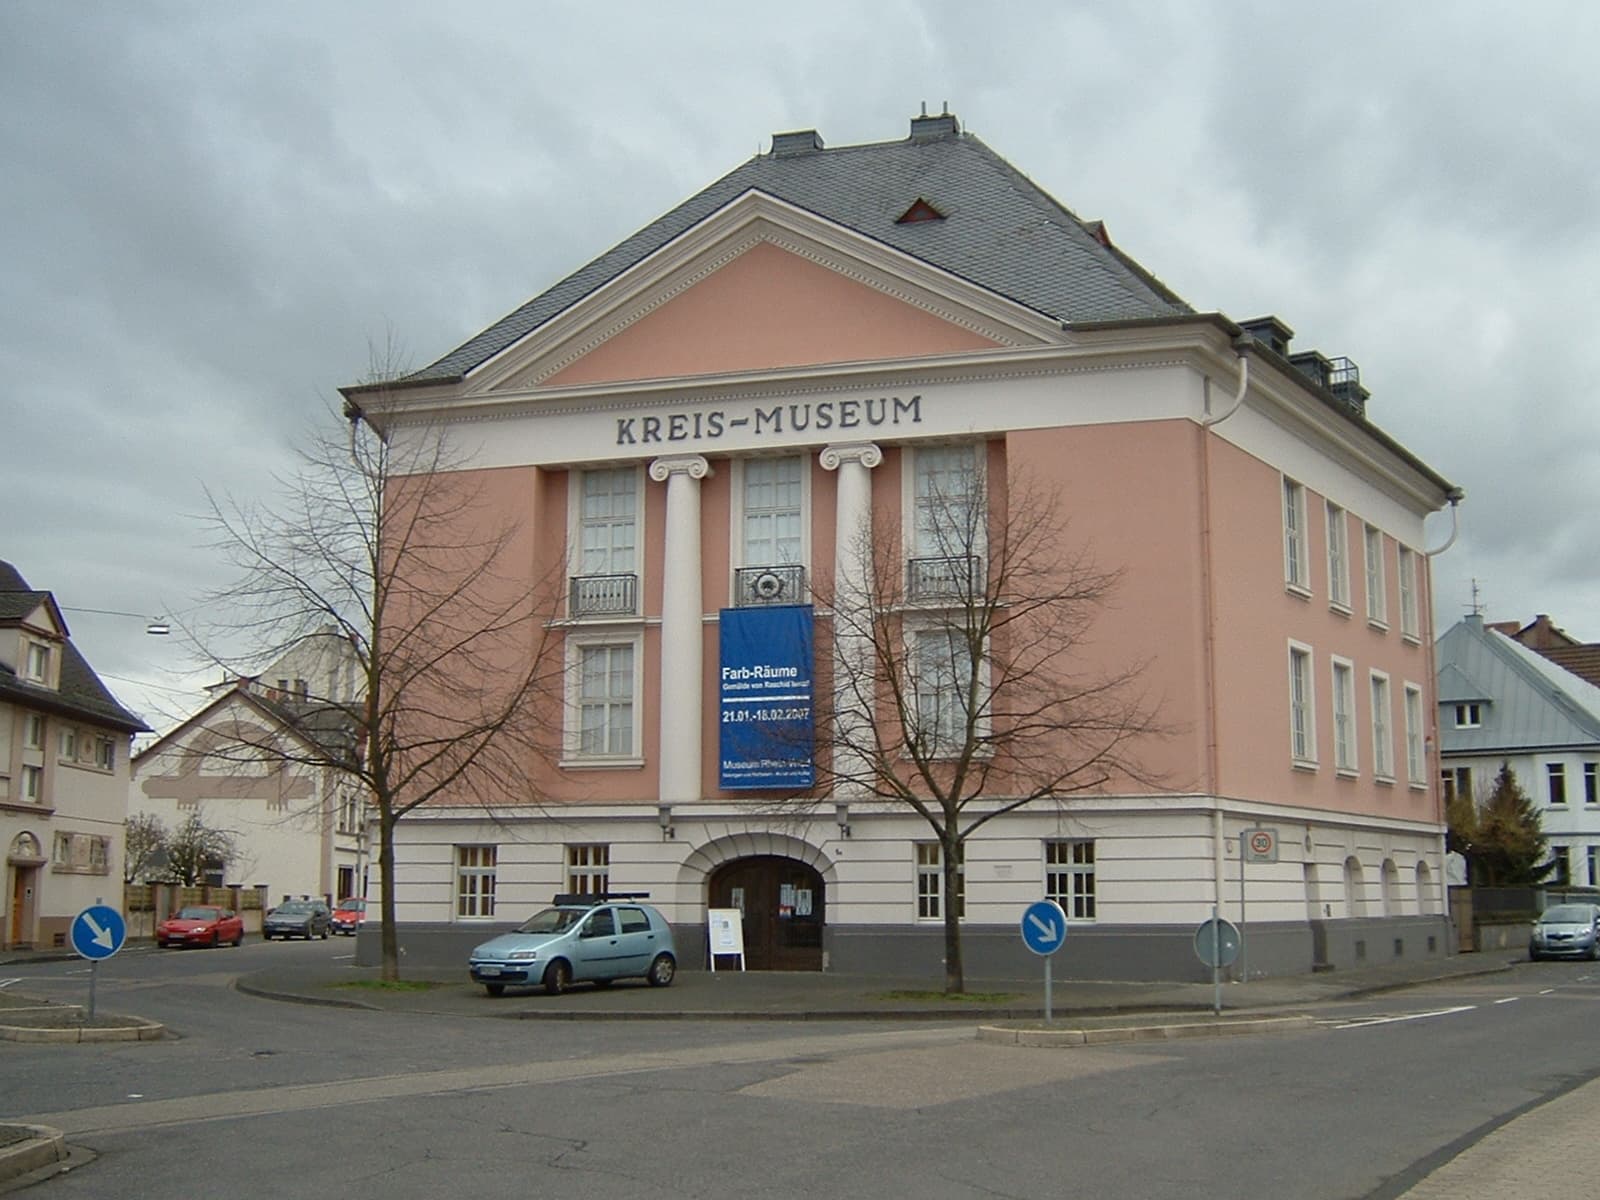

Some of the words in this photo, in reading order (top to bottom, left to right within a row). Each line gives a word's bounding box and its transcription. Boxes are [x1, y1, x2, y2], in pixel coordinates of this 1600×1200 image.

[616, 395, 922, 444] KREIS-MUSEUM
[722, 665, 797, 680] Farb-Räume
[1256, 838, 1267, 848] 30
